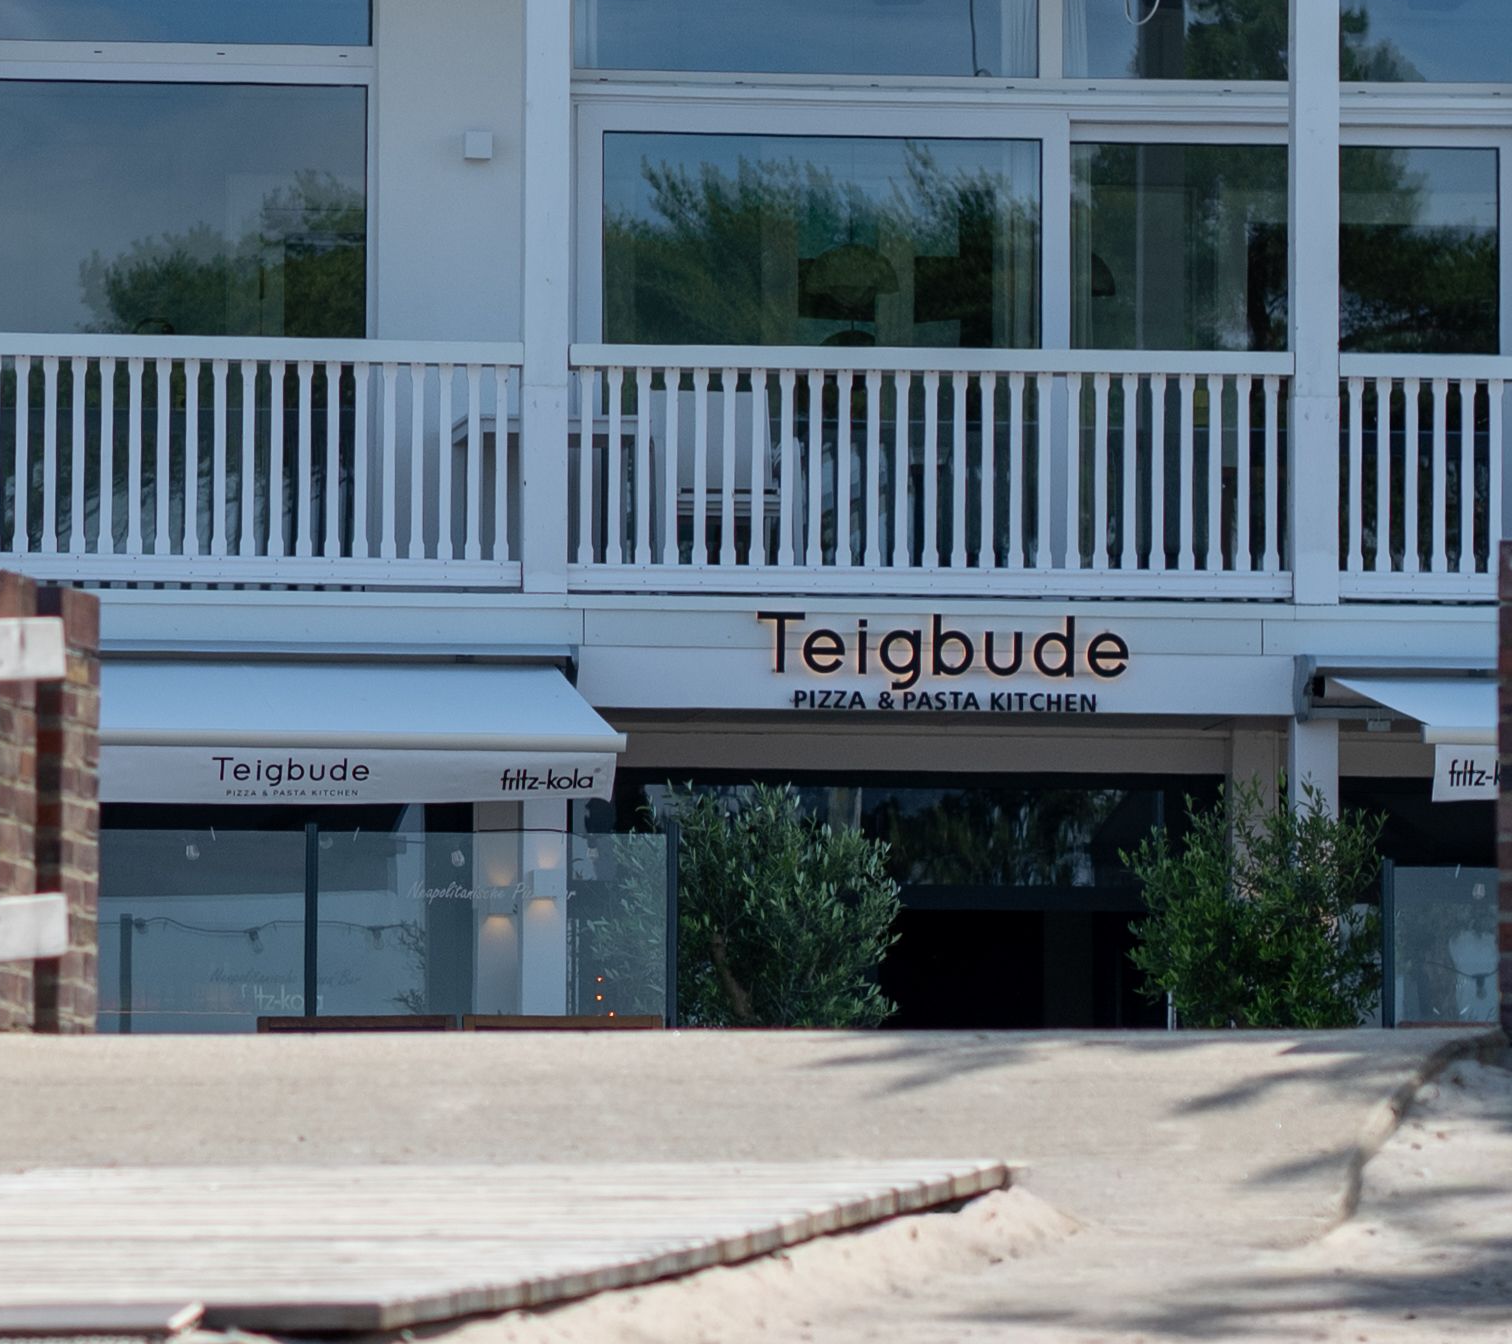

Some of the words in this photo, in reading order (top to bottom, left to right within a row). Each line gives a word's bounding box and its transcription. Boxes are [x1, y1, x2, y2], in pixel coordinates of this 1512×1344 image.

[757, 610, 1130, 690] Teigbude
[793, 689, 867, 710] PIZZA
[877, 690, 895, 711] &
[902, 690, 981, 712] PASTA
[989, 692, 1098, 713] KITCHEN
[211, 756, 370, 787] Teigbude
[500, 767, 594, 791] fritz-kola
[225, 789, 257, 797] PIZZA
[262, 789, 269, 797] &
[273, 789, 307, 797] PASTA
[311, 789, 359, 797] KITCHEN
